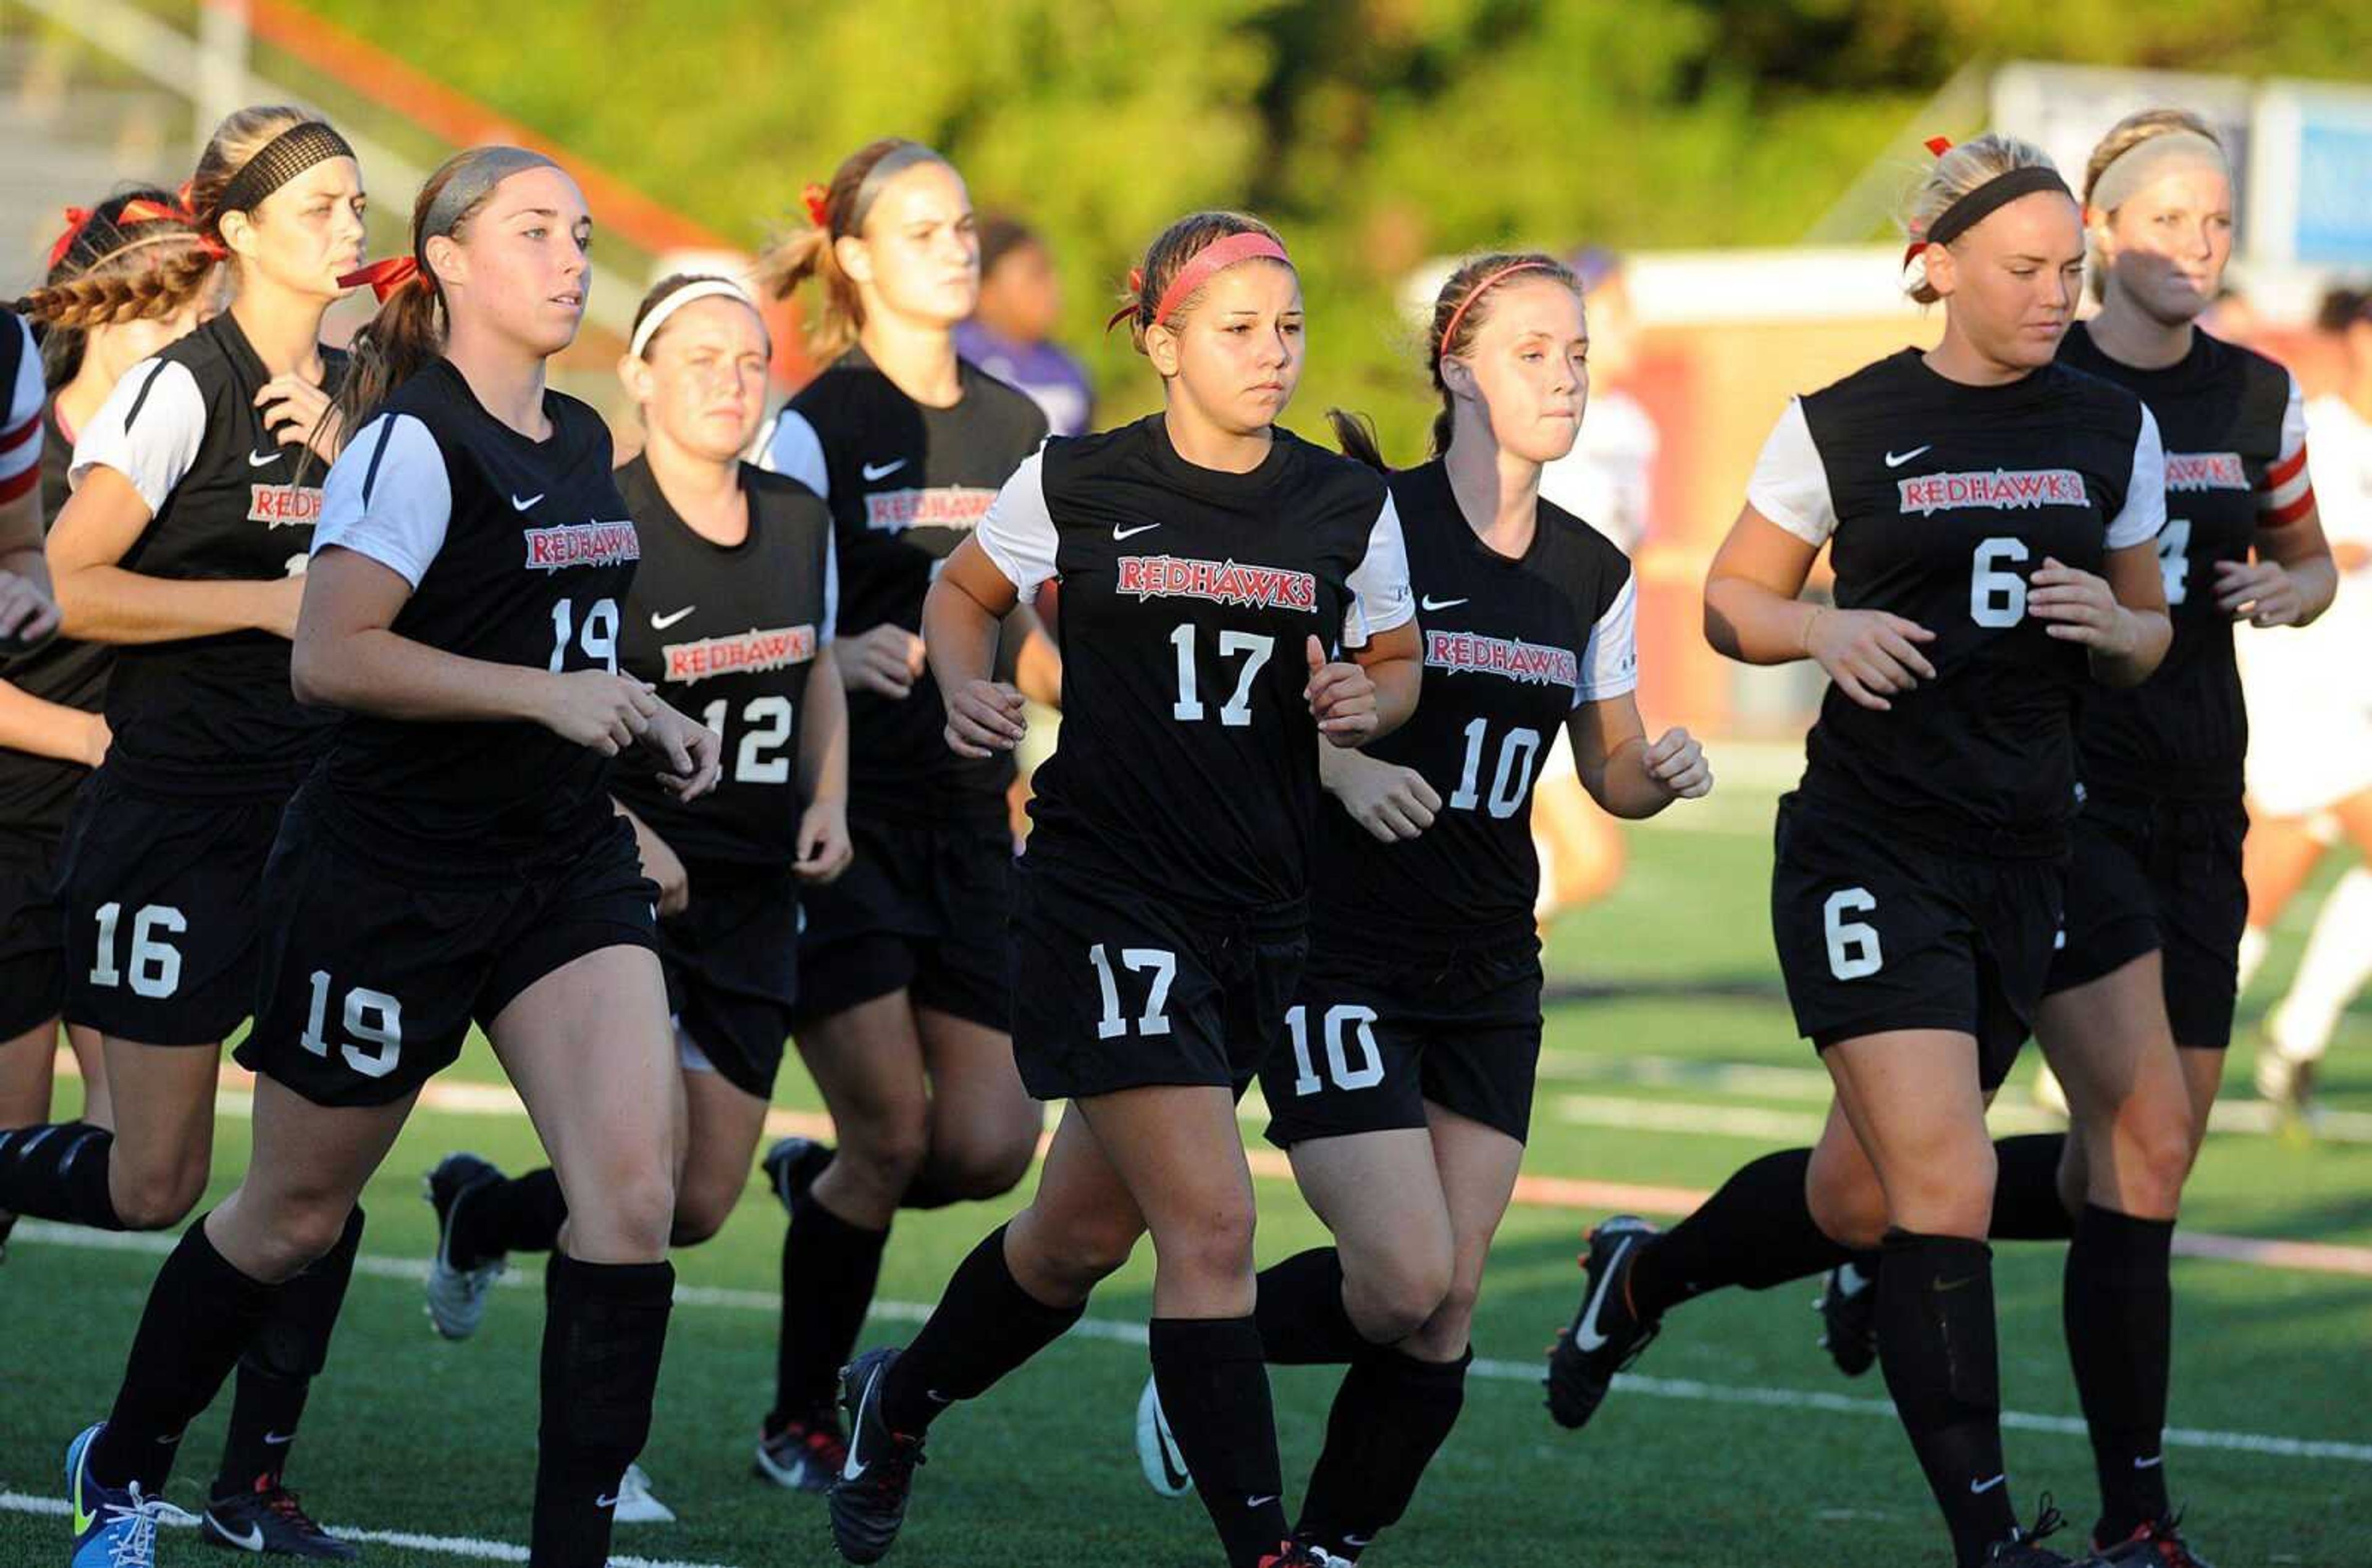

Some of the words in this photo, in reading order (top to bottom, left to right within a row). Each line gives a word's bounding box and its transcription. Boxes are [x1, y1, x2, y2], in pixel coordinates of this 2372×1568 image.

[1903, 471, 2085, 511] REDHAWKS
[1119, 556, 1315, 610] REDHAWKS
[1970, 537, 2029, 627] 6
[549, 598, 619, 676] 19
[1171, 624, 1275, 726] 17
[702, 696, 793, 783] 12
[1450, 718, 1541, 818] 10
[90, 902, 187, 999] 16
[1824, 887, 1883, 981] 6
[300, 970, 402, 1078] 19
[1090, 944, 1175, 1039] 17
[1285, 1004, 1385, 1096] 10
